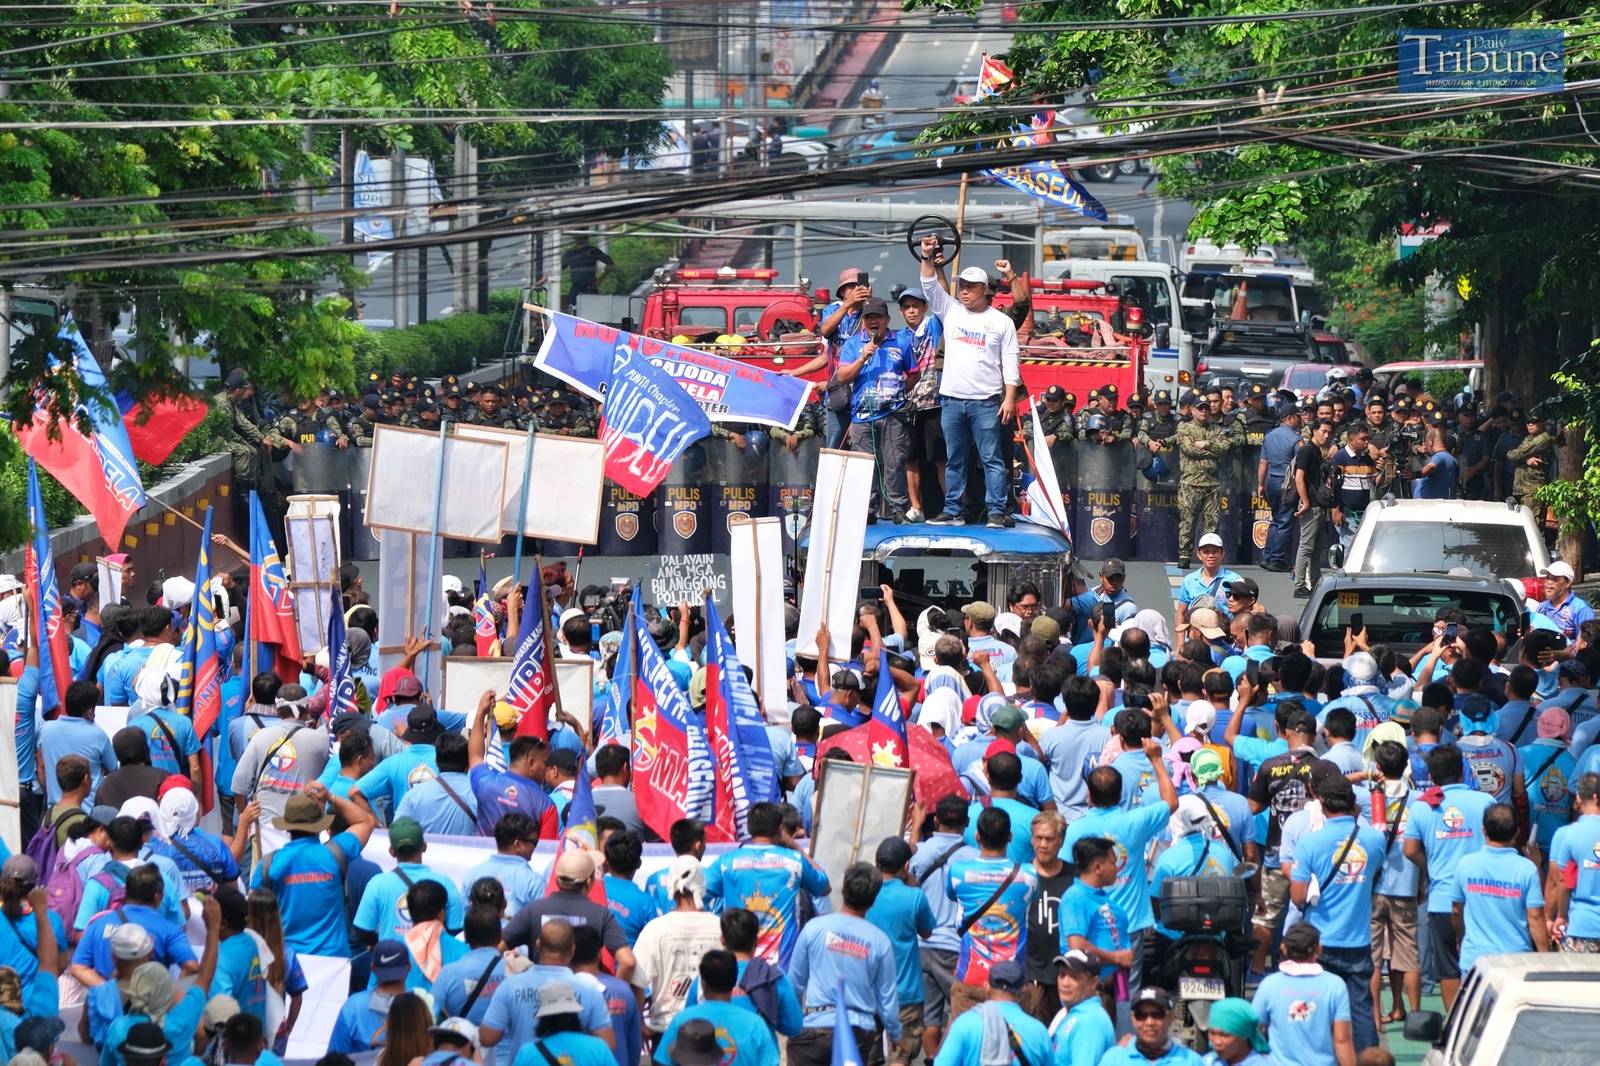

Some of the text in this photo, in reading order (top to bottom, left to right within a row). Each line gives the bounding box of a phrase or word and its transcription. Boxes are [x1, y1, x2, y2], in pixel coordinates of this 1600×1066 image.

[668, 488, 700, 501] PULIS
[723, 488, 755, 501] PULIS
[1088, 493, 1121, 506] PULIS
[674, 502, 697, 511] MPD
[728, 502, 751, 511] MPD
[661, 553, 714, 567] PALAYAIN
[657, 563, 714, 579] ANG MGA
[651, 574, 727, 594] BILANGGONG
[656, 589, 721, 605] POLITIKL
[1467, 876, 1522, 898] MANIBELA
